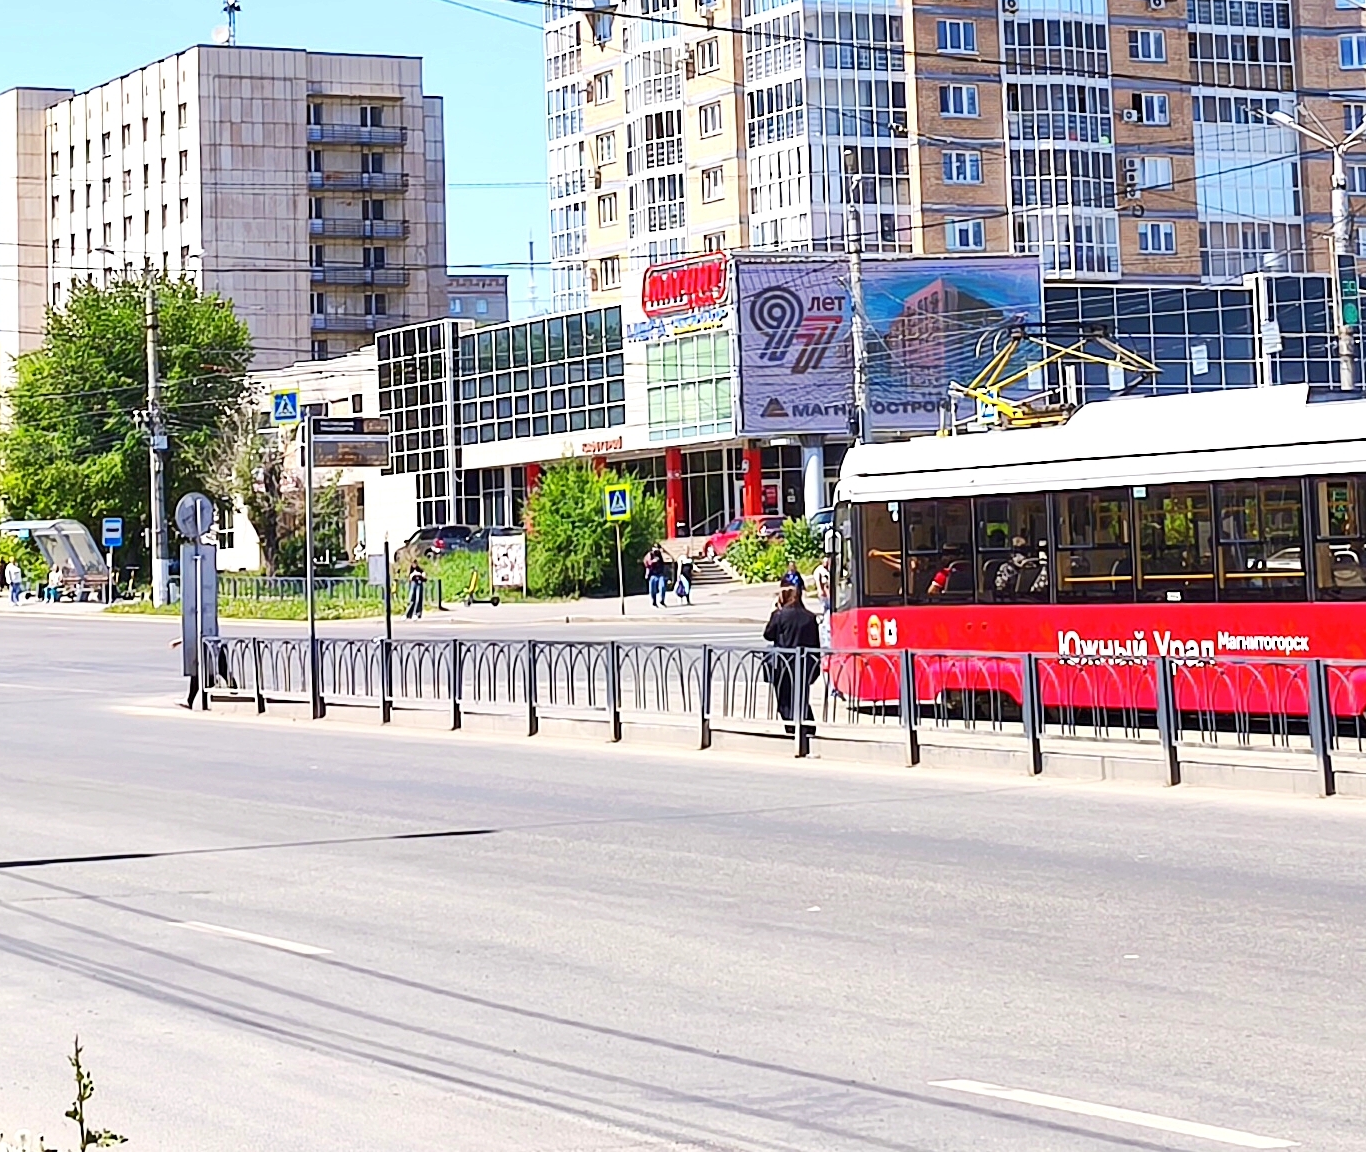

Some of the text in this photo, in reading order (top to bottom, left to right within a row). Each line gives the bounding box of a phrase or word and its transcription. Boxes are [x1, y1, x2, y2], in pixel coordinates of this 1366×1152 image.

[808, 296, 845, 311] лет
[750, 287, 843, 374] 97
[1057, 630, 1216, 675] Южный Урал
[1217, 631, 1310, 656] Магнитогорск
